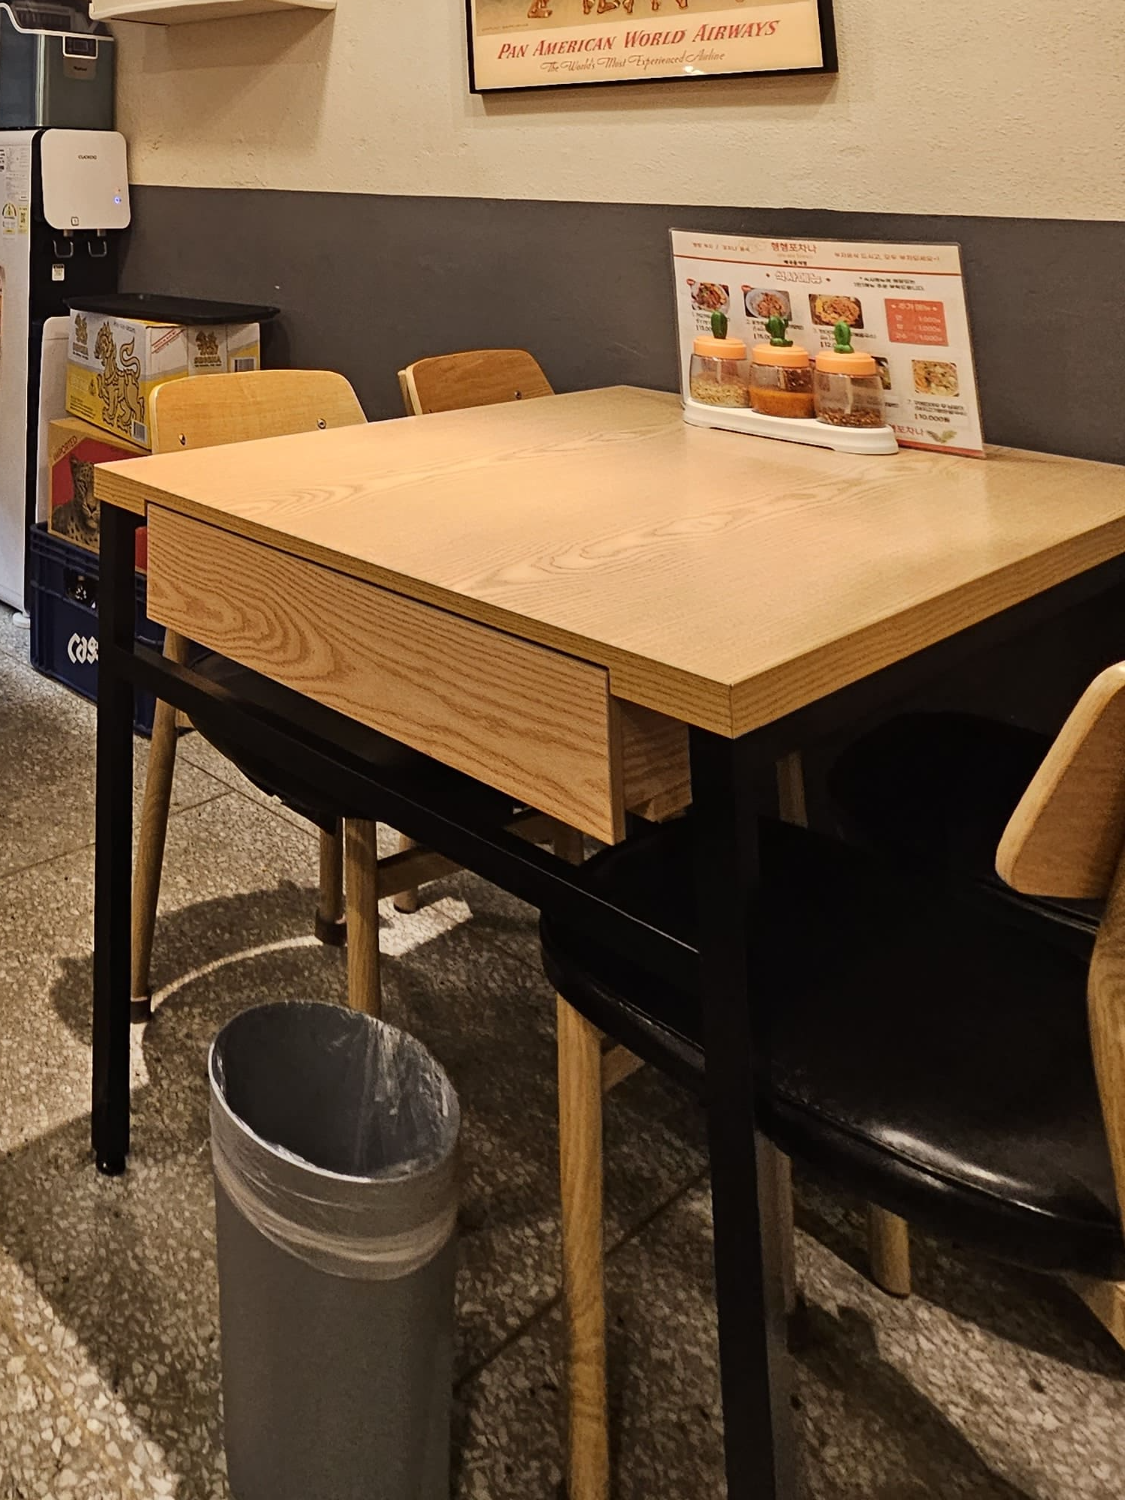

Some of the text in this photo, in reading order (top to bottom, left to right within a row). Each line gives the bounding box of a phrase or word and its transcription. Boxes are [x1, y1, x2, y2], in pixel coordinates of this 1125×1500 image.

[497, 19, 781, 60] PAN AMERICAN WORLD AIRWAYS
[540, 48, 726, 73] The World's Most Experienced Airline
[890, 423, 924, 437] 포차나
